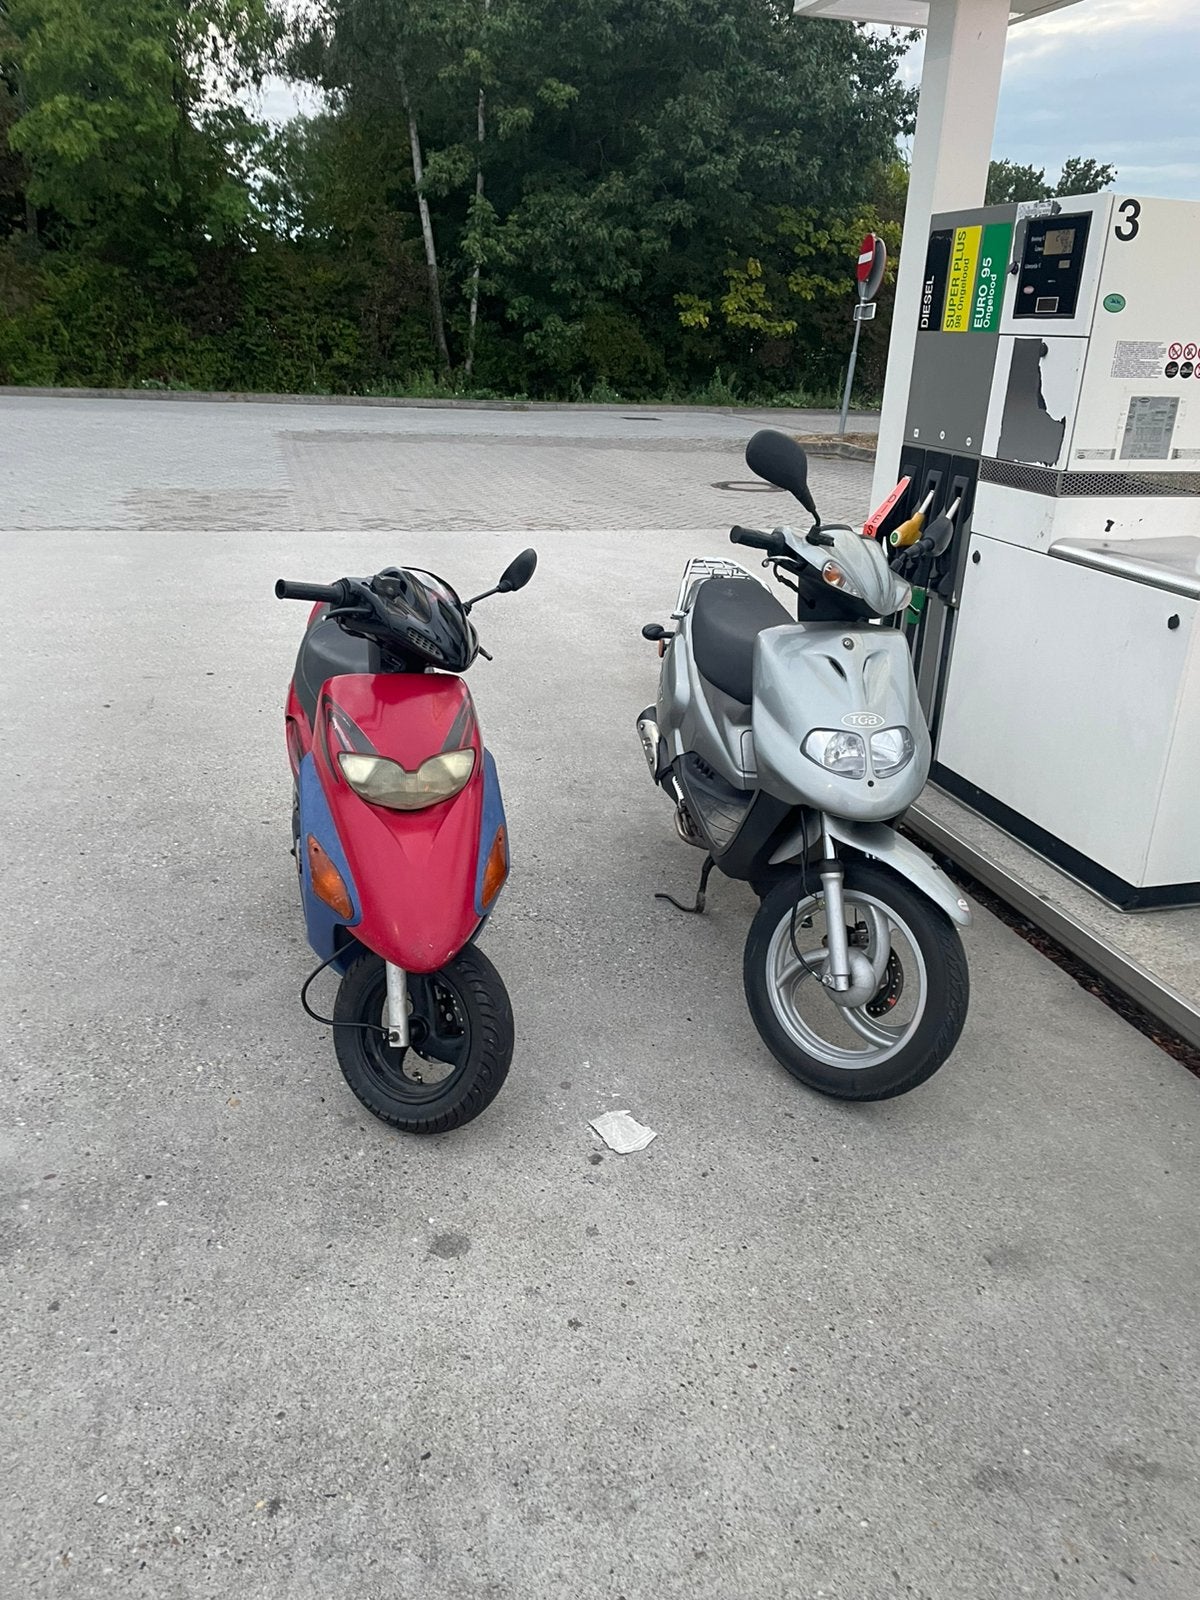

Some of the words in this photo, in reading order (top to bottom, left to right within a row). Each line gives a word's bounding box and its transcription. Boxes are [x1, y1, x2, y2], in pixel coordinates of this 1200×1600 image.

[1115, 199, 1141, 241] 3
[921, 275, 935, 328] DIESEL
[946, 277, 960, 328] SUPER
[954, 231, 966, 271] PLUS
[957, 258, 970, 310] Ongelood
[974, 284, 988, 328] EURO
[981, 257, 993, 277] 95
[983, 274, 997, 328] Ongelood
[954, 314, 962, 328] 98
[850, 715, 878, 725] TGB
